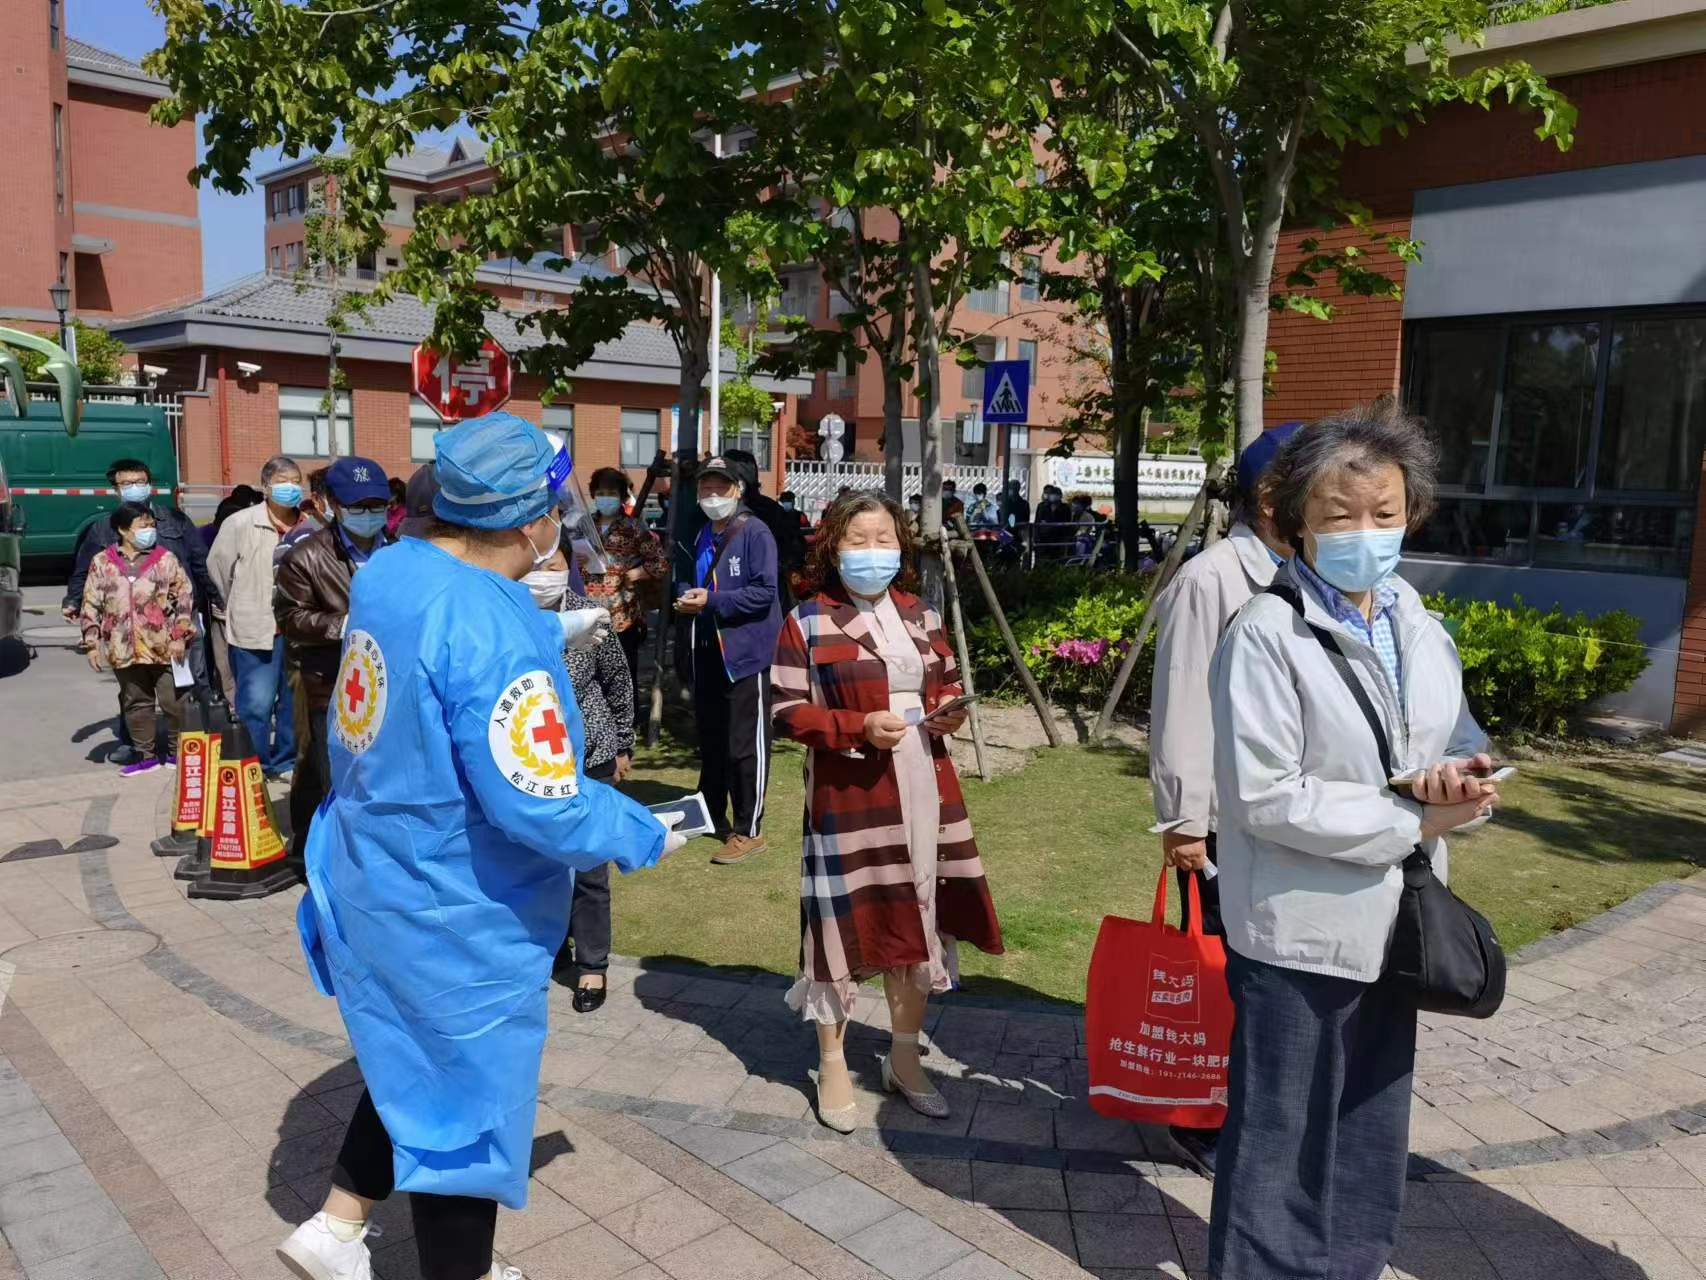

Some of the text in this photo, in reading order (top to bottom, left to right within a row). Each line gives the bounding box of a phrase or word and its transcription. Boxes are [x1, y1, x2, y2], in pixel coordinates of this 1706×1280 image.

[432, 346, 496, 406] 停
[494, 678, 534, 729] 人道救助
[511, 771, 578, 797] 松江区红
[1139, 1021, 1207, 1047] 加盟钱大妈
